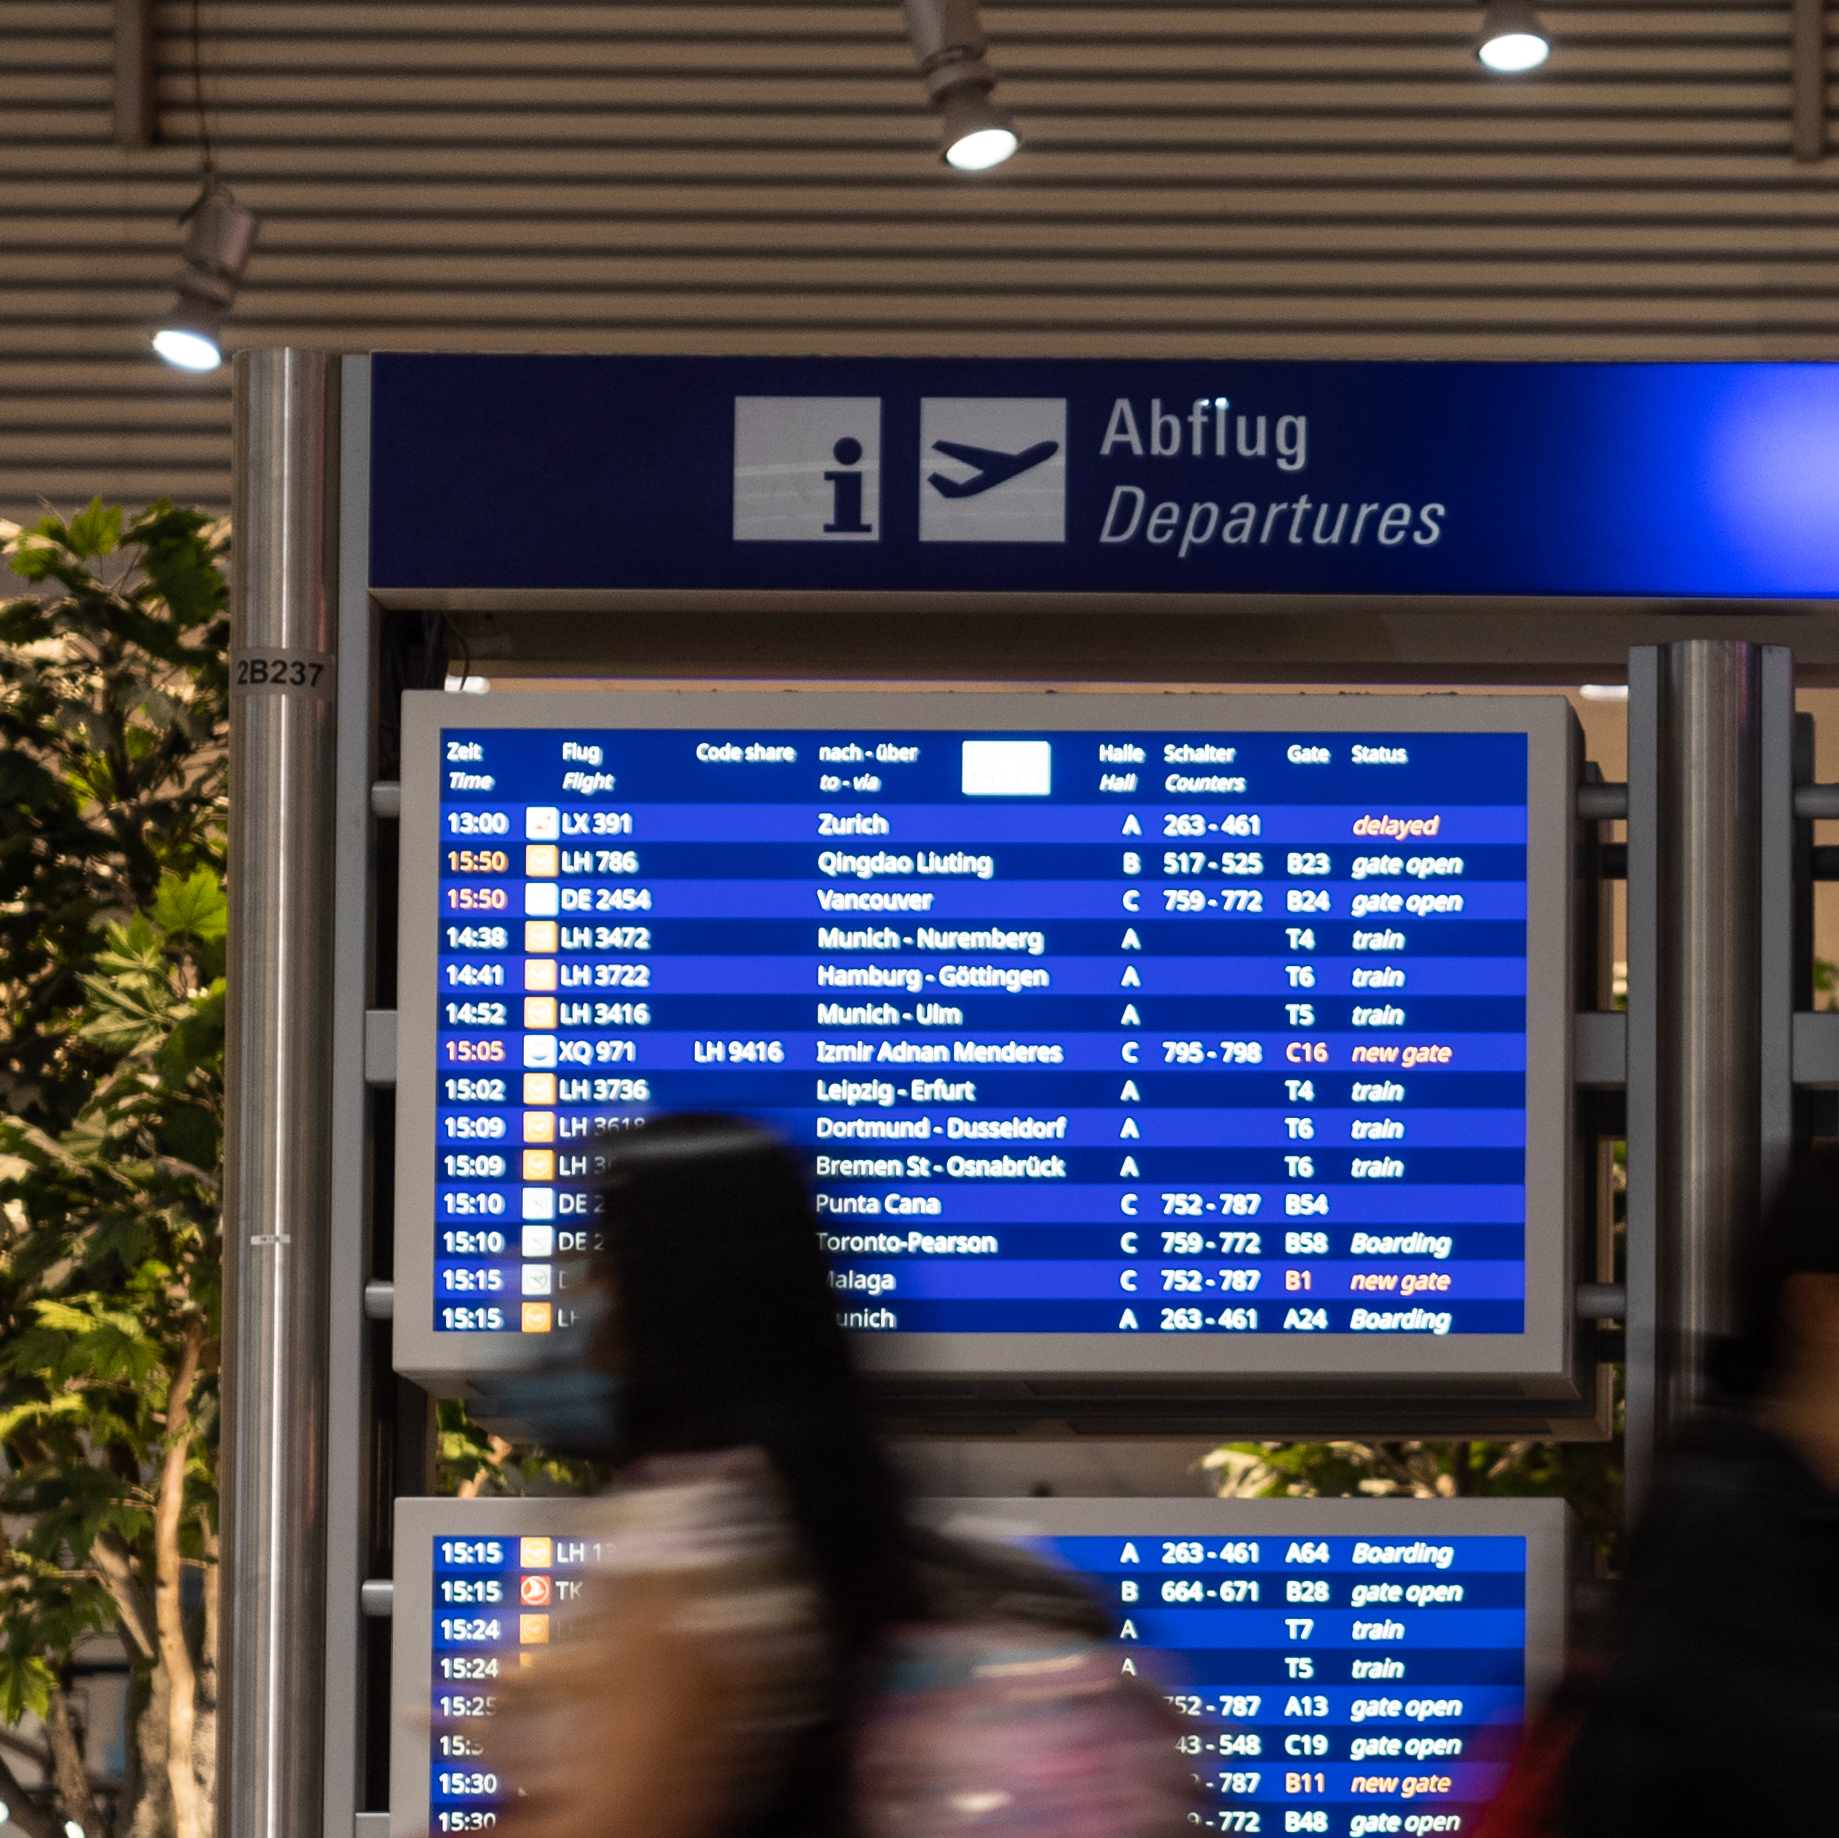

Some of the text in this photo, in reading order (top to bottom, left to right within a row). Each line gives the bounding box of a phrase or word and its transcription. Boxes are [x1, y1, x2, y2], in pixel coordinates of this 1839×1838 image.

[1099, 397, 1308, 472] Abflug
[1099, 484, 1446, 559] Departures
[236, 659, 325, 688] 2B237
[446, 741, 482, 761] Zeit
[562, 742, 602, 765] Flug
[696, 742, 796, 762] Code share
[1099, 743, 1145, 763] Halle
[1163, 743, 1236, 763] Schalter
[1287, 744, 1330, 763] Gate
[1351, 744, 1408, 763] Status
[449, 771, 494, 790] Time
[562, 771, 615, 794] Flight
[1099, 773, 1137, 792] Hall
[1165, 773, 1246, 792] Counters
[447, 812, 509, 834] 13:00
[561, 812, 632, 835] LX 391
[817, 812, 889, 836] Zurich
[1352, 814, 1441, 842] delayed
[447, 850, 509, 872] 15:50
[561, 850, 639, 873] LH 786
[817, 850, 993, 879] Qingdao Liuting
[1287, 852, 1330, 875] B23
[1351, 854, 1463, 879] gate open
[816, 889, 934, 911] Vancouver
[445, 1040, 506, 1062] 15:05
[694, 1040, 784, 1063] LH 9416
[816, 1040, 1064, 1063] Izmir Adnan Menderes
[1285, 1041, 1329, 1063] C16
[1351, 1044, 1453, 1069] new gate
[816, 1193, 941, 1215] Punta Cana
[1349, 1307, 1452, 1331] Boarding
[1285, 1542, 1330, 1564] A64
[1352, 1541, 1454, 1569] Boarding
[1286, 1580, 1329, 1602] B28
[1350, 1582, 1463, 1607] gate open
[1284, 1618, 1314, 1640] T7
[1351, 1618, 1405, 1640] train
[1284, 1734, 1328, 1756] C19
[1285, 1810, 1328, 1833] B48
